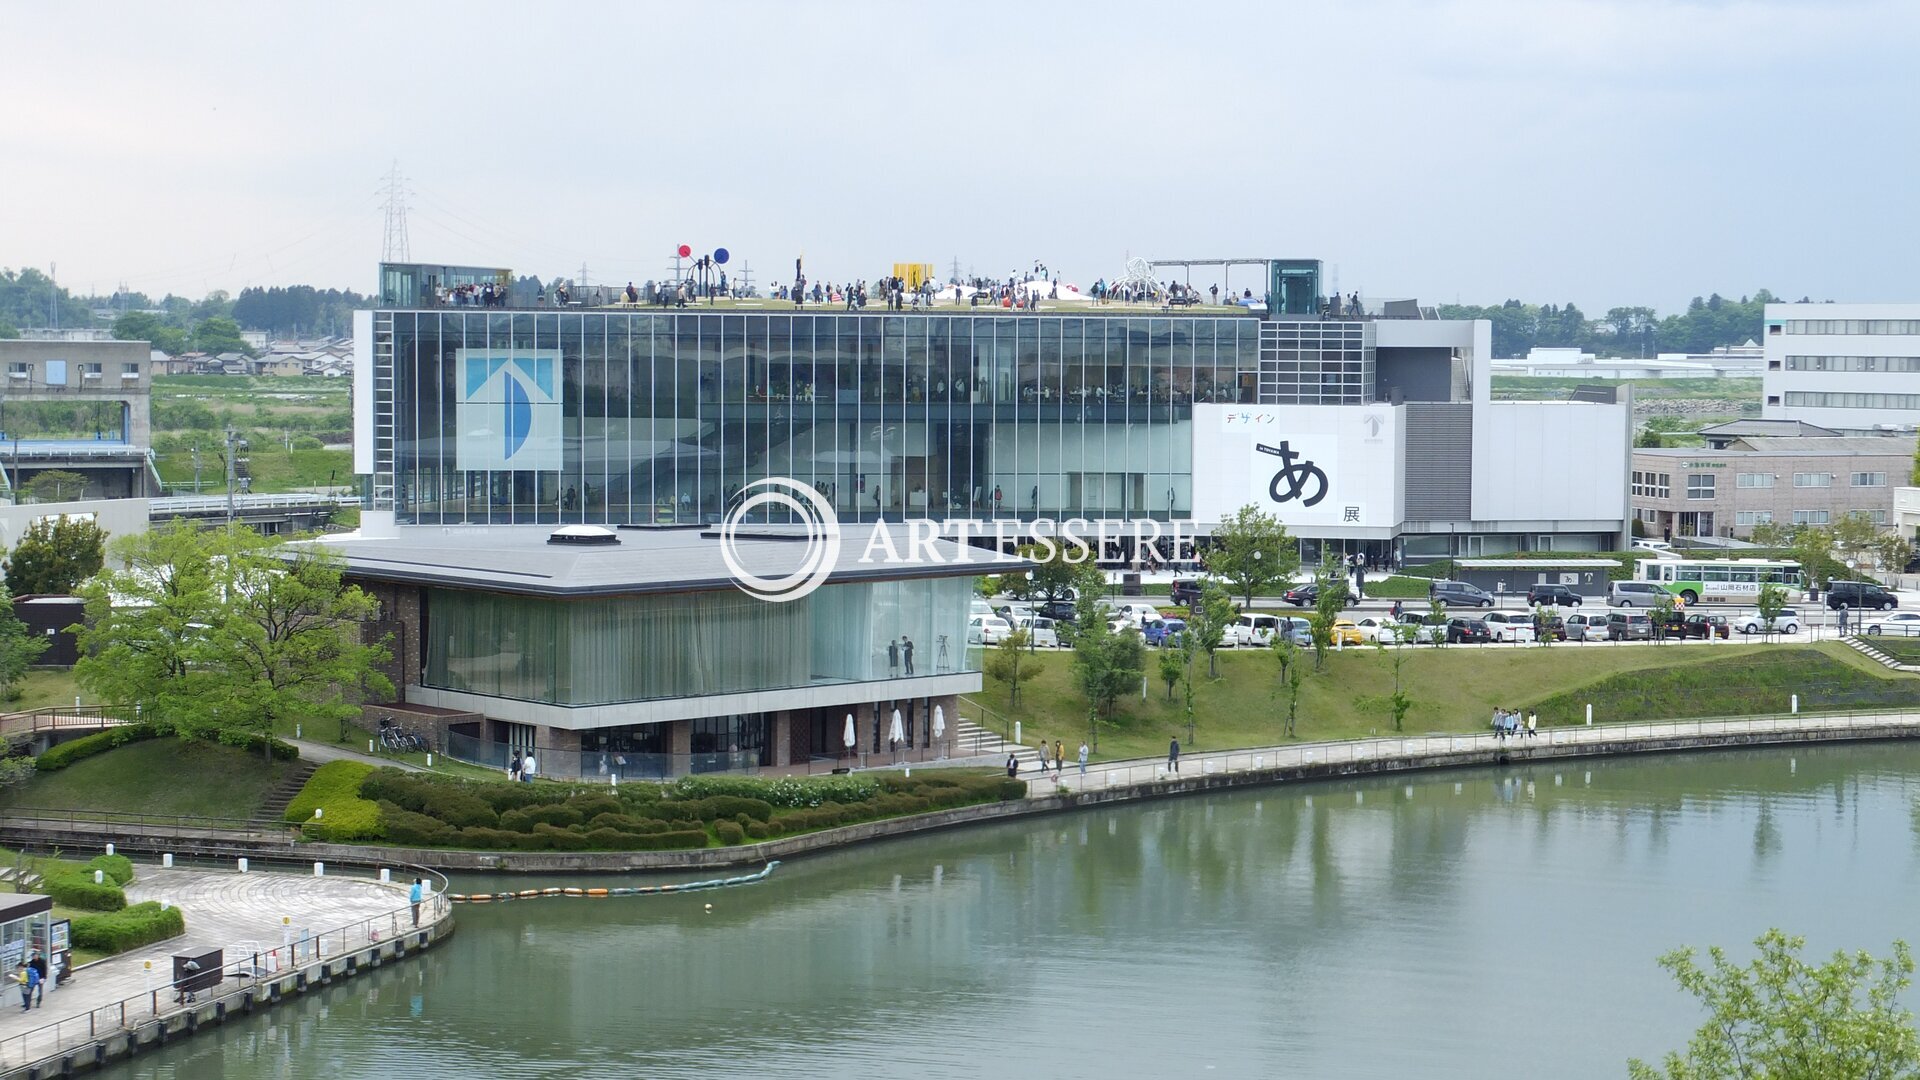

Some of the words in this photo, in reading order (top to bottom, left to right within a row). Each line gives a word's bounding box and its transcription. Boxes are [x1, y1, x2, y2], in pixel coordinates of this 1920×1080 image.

[1226, 412, 1275, 424] デザイン
[1255, 440, 1329, 507] あ
[1343, 506, 1360, 522] 展
